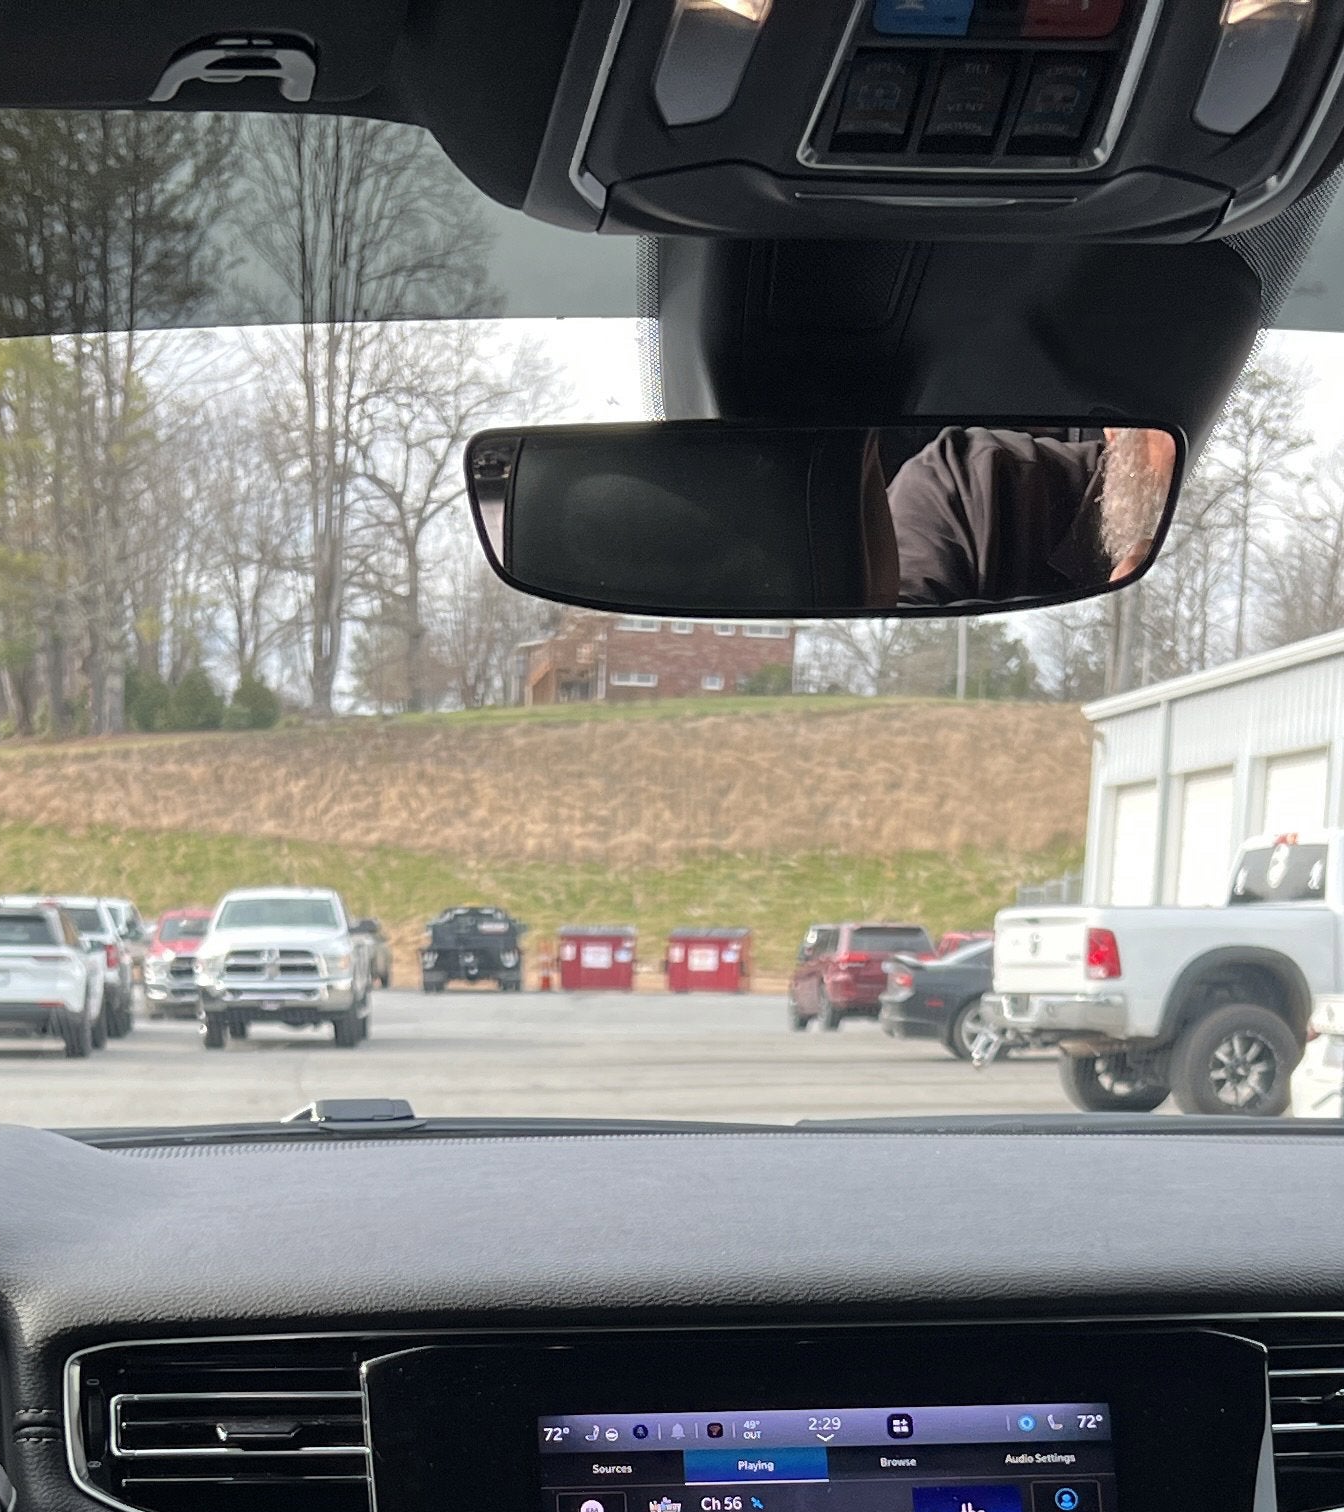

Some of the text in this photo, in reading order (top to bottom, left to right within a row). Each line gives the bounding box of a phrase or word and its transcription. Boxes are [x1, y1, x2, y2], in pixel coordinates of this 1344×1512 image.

[808, 1417, 841, 1431] 2:29
[1077, 1414, 1103, 1429] 72°
[544, 1426, 570, 1442] 72°
[880, 1457, 917, 1468] Browse
[1005, 1452, 1076, 1464] Audio Settings
[592, 1464, 632, 1475] Sources
[737, 1460, 774, 1473] Playing
[701, 1497, 742, 1511] Ch 56
